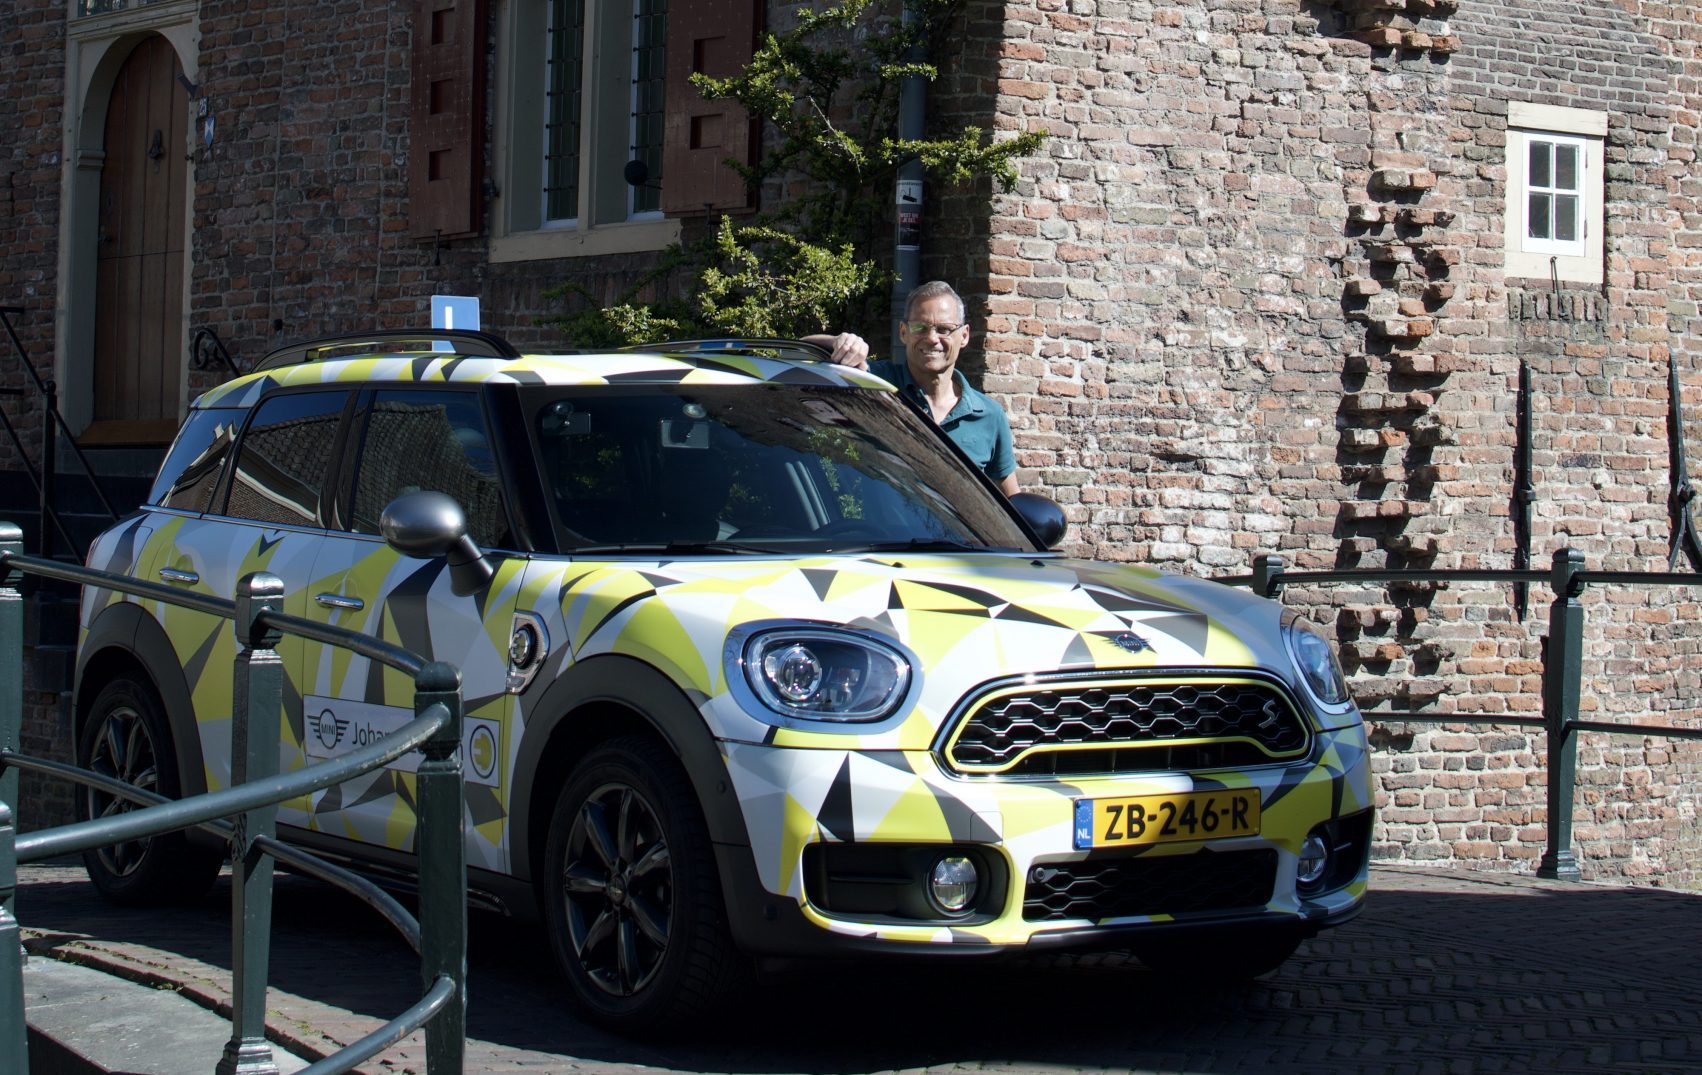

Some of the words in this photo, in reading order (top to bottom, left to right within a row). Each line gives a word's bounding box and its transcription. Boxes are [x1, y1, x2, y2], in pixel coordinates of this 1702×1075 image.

[321, 723, 336, 735] MINI
[352, 721, 391, 745] Joha
[1104, 796, 1249, 841] ZB-246-R
[1077, 828, 1091, 840] NL
